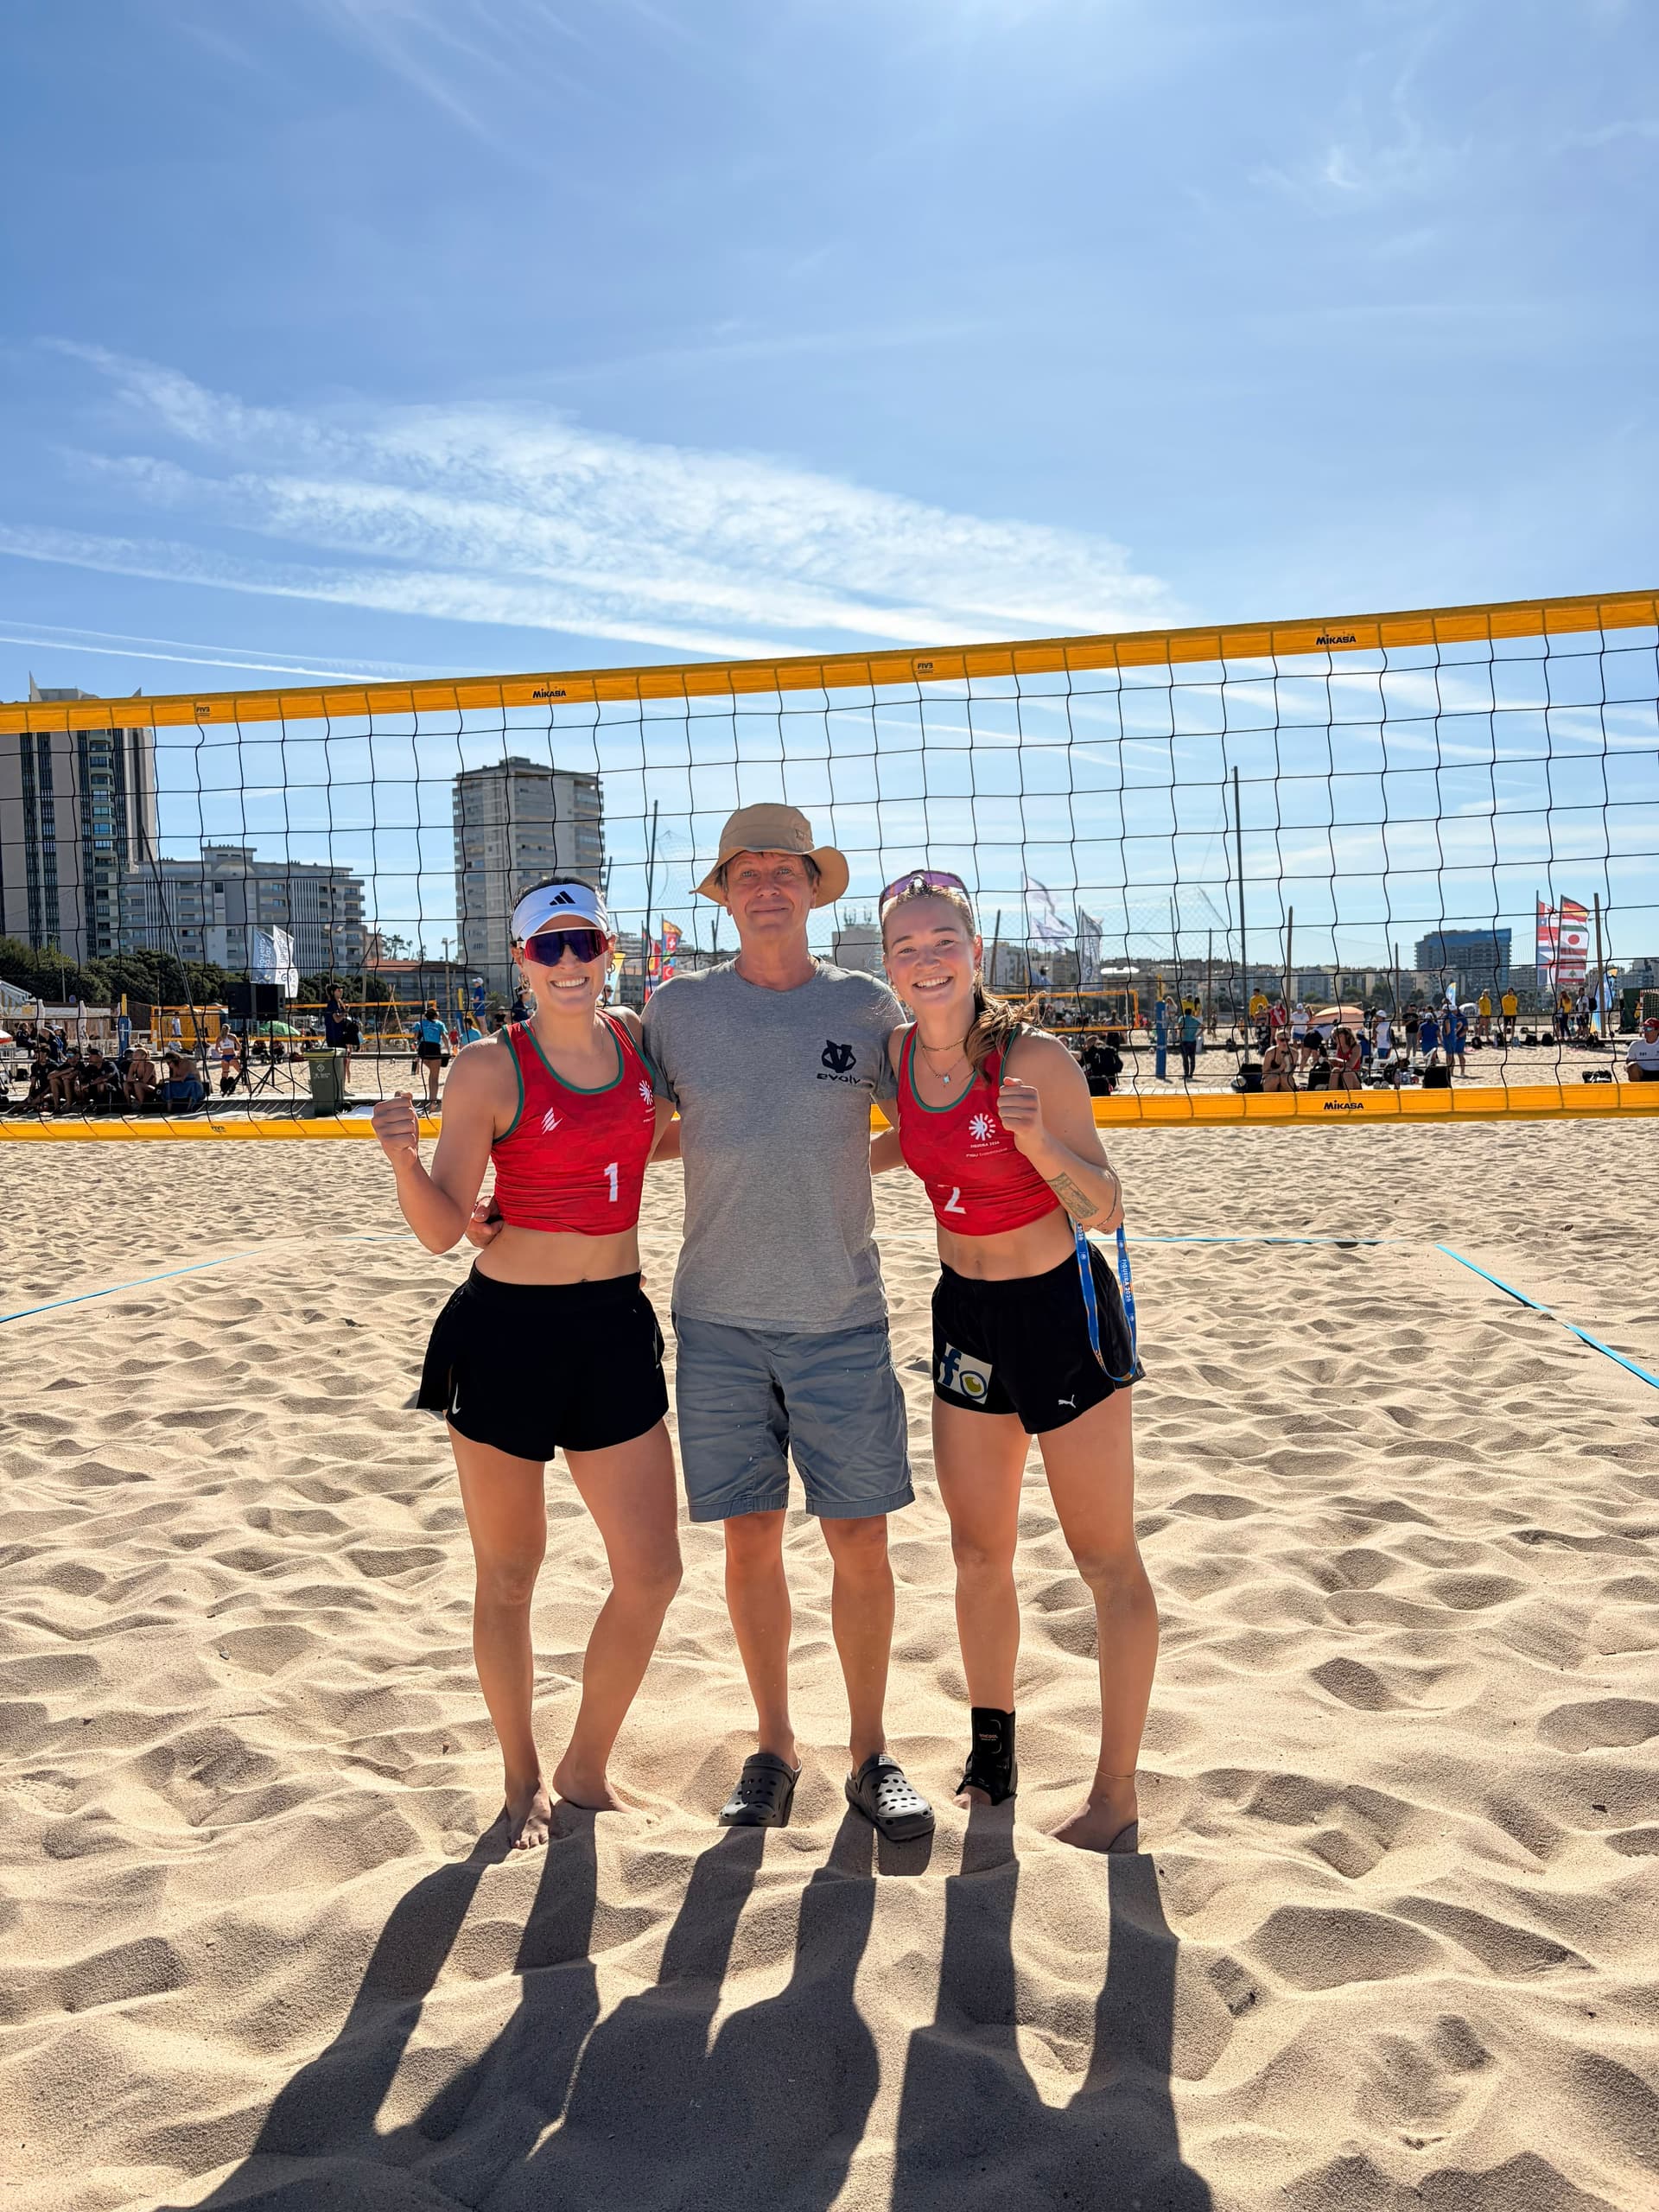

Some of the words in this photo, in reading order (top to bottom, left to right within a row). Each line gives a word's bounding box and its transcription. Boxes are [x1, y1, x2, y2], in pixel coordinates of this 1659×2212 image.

[817, 1072, 861, 1084] evolv
[604, 1162, 618, 1202] 1
[942, 1185, 967, 1215] 2
